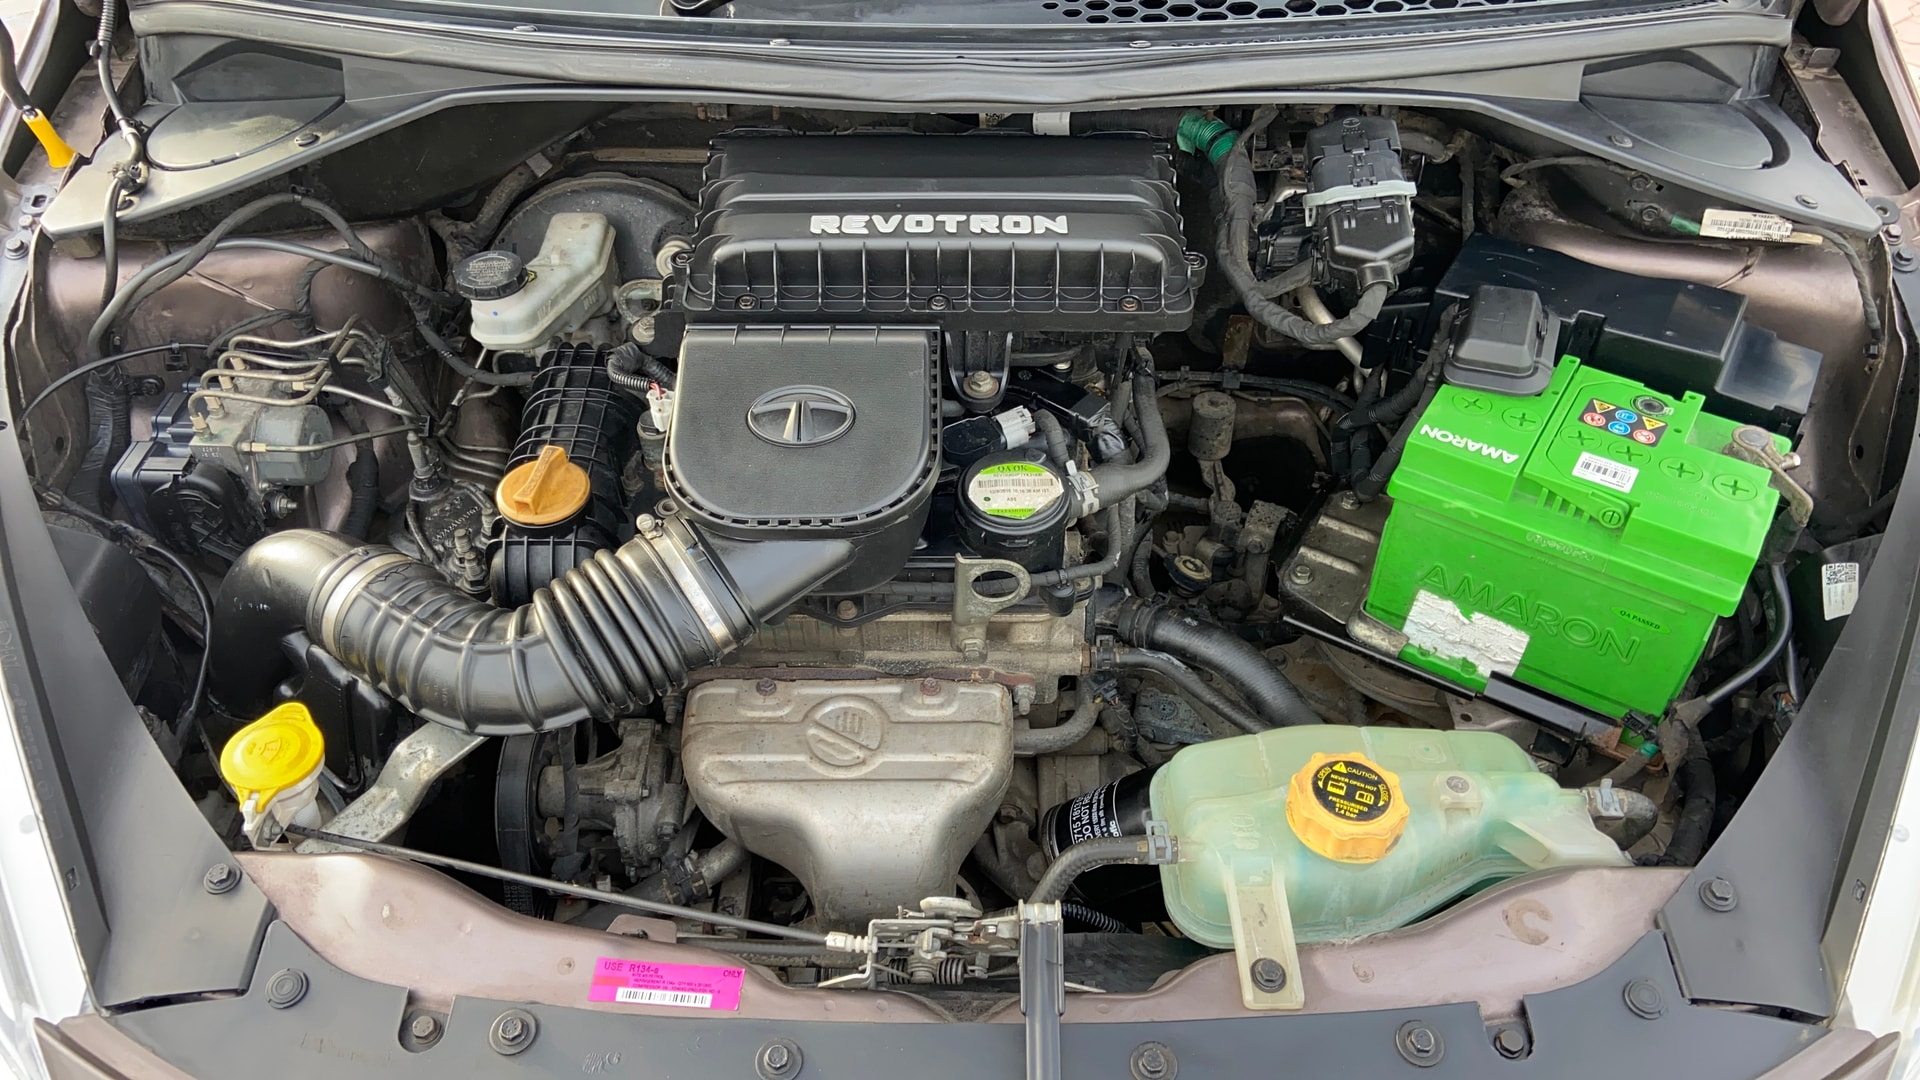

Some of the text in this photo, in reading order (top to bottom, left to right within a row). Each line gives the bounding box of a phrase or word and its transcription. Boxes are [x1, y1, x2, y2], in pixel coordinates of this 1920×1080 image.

[810, 214, 1069, 235] REVOTRON
[1420, 424, 1519, 464] AMARON
[1013, 464, 1028, 472] OK
[1418, 562, 1641, 665] AMARON
[1620, 610, 1661, 630] QA PASSED
[1331, 774, 1349, 783] NEVER
[1349, 780, 1364, 788] OPEN
[1347, 767, 1378, 780] CAUTION
[1328, 796, 1368, 812] PRESSURISED
[1335, 803, 1359, 814] SYSTEM
[1335, 807, 1345, 815] 1.4
[1081, 804, 1090, 825] NOT
[604, 961, 624, 972] USE
[722, 969, 743, 979] ONLY
